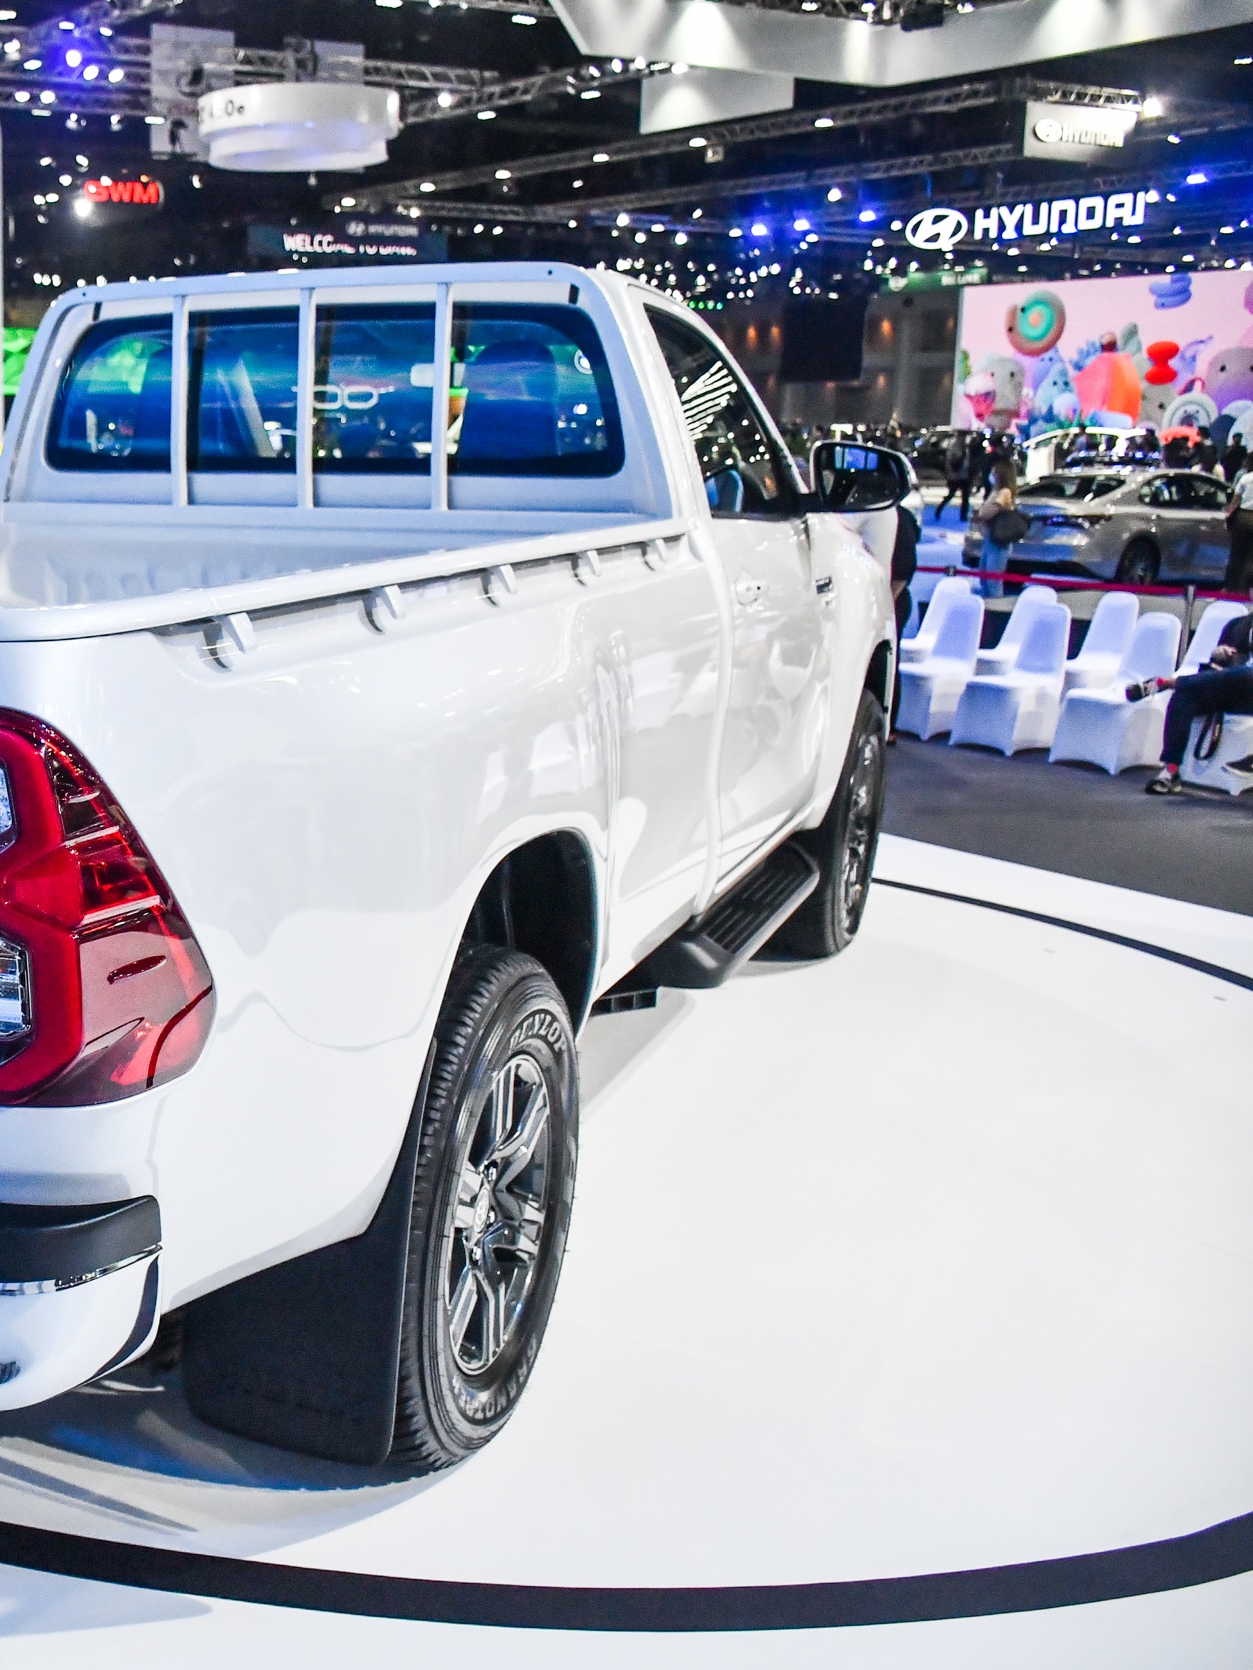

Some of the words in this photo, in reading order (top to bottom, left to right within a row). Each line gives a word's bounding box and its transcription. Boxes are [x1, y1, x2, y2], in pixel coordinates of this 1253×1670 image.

[84, 179, 159, 204] GWM
[973, 191, 1147, 240] HYUNDAI
[508, 1013, 567, 1054] DUNLOP
